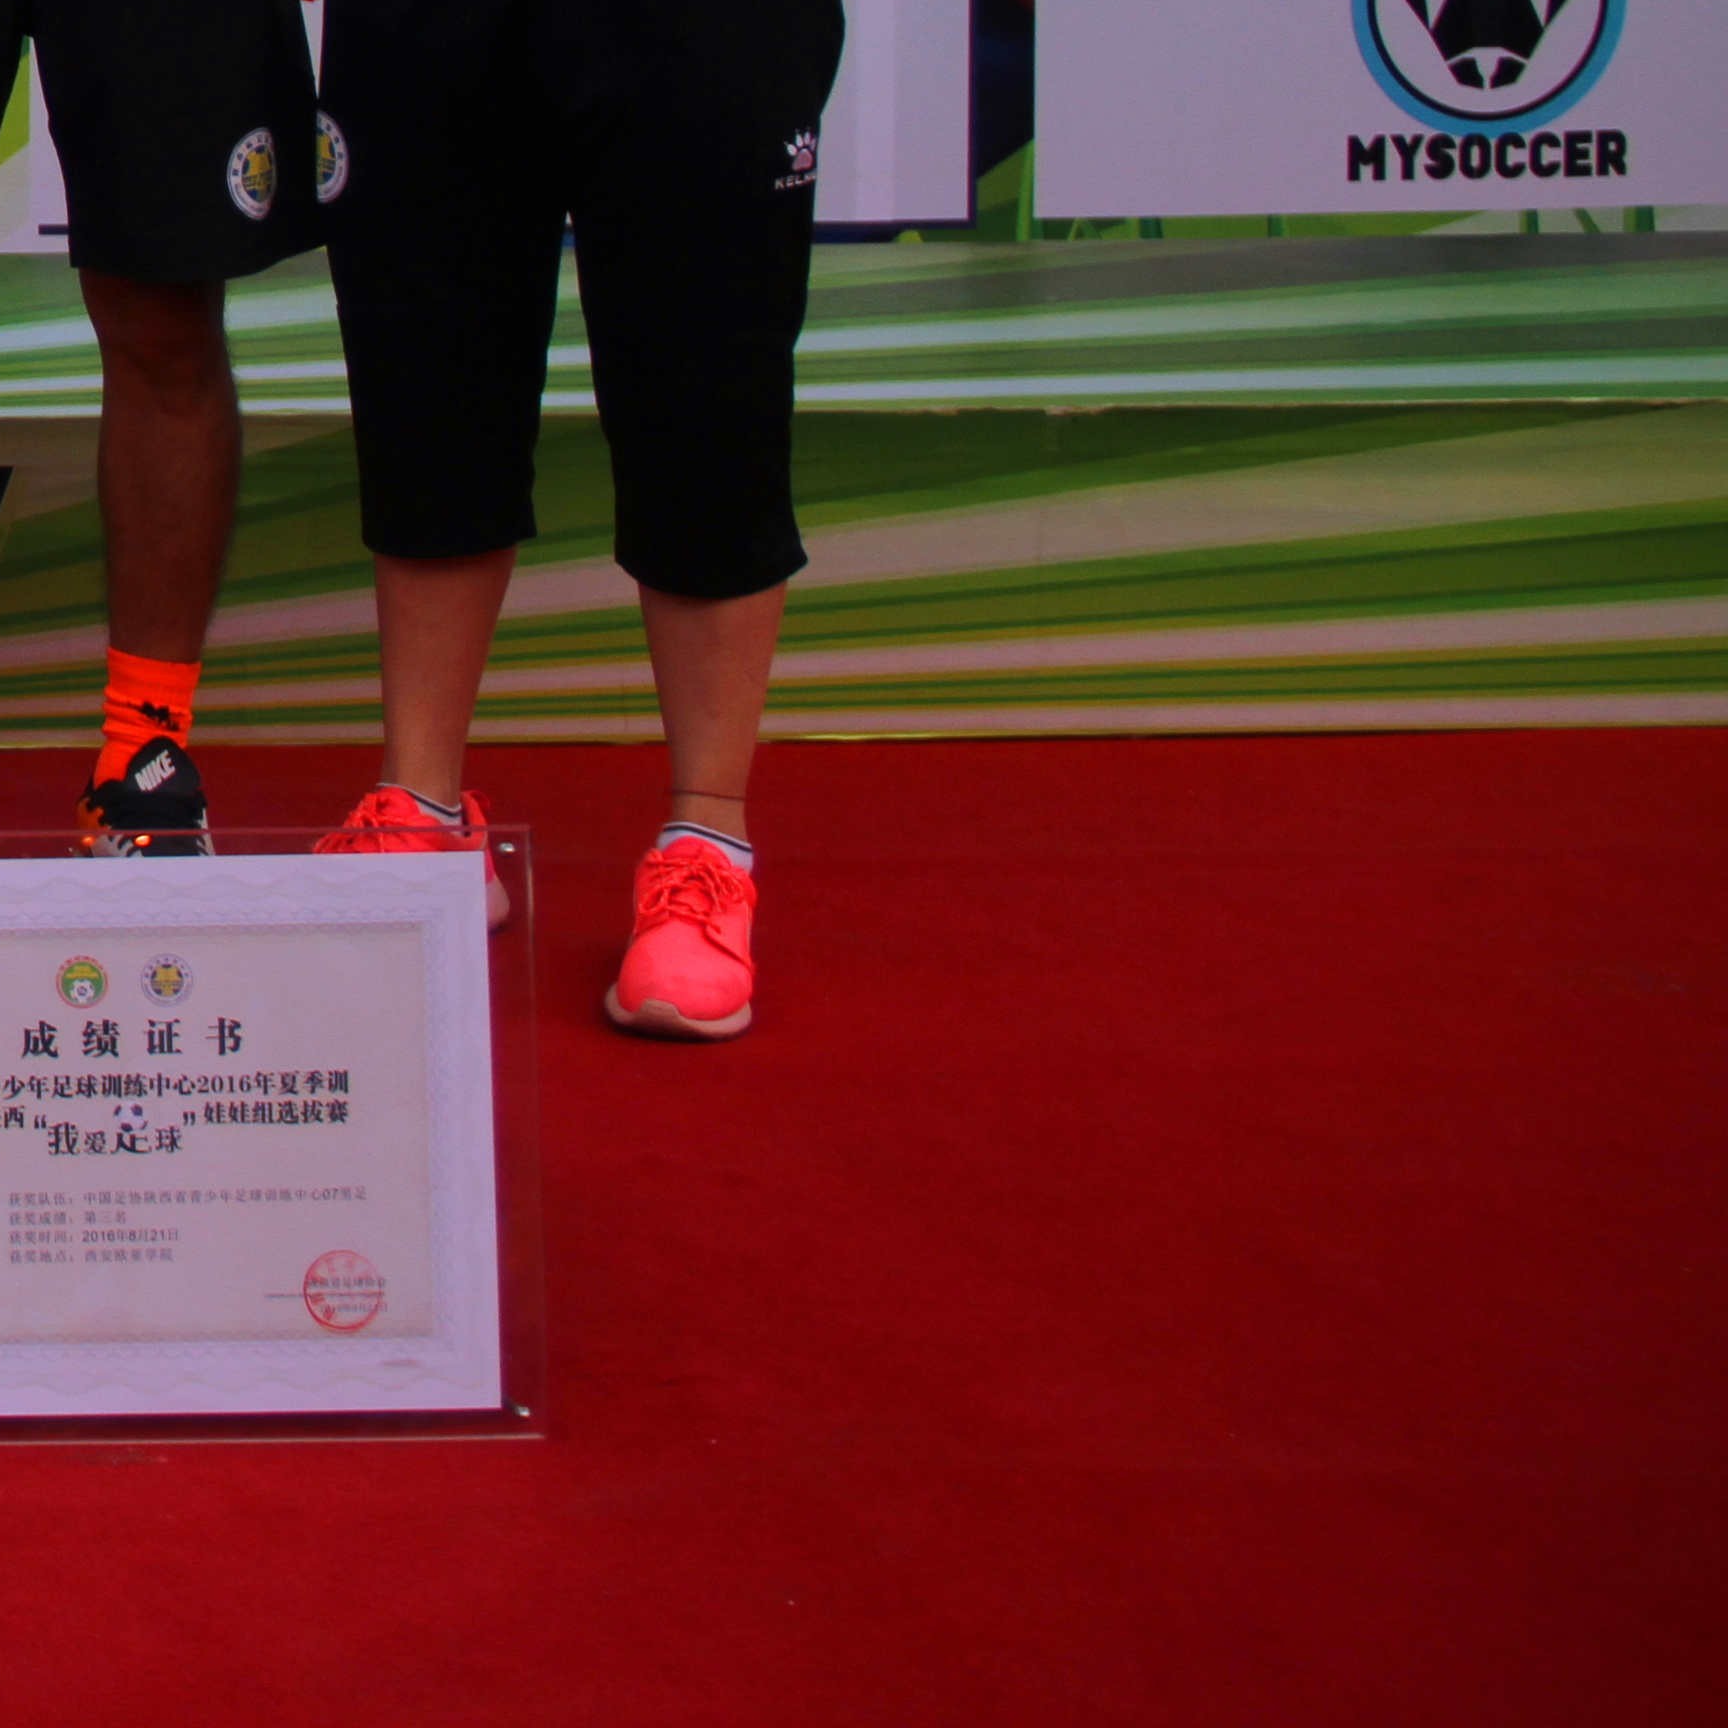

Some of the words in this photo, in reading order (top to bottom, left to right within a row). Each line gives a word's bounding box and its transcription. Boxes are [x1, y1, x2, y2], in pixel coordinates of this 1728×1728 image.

[1346, 130, 1628, 182] MYSOCCER
[133, 747, 177, 793] NIKE
[20, 1016, 245, 1060] 成绩证书
